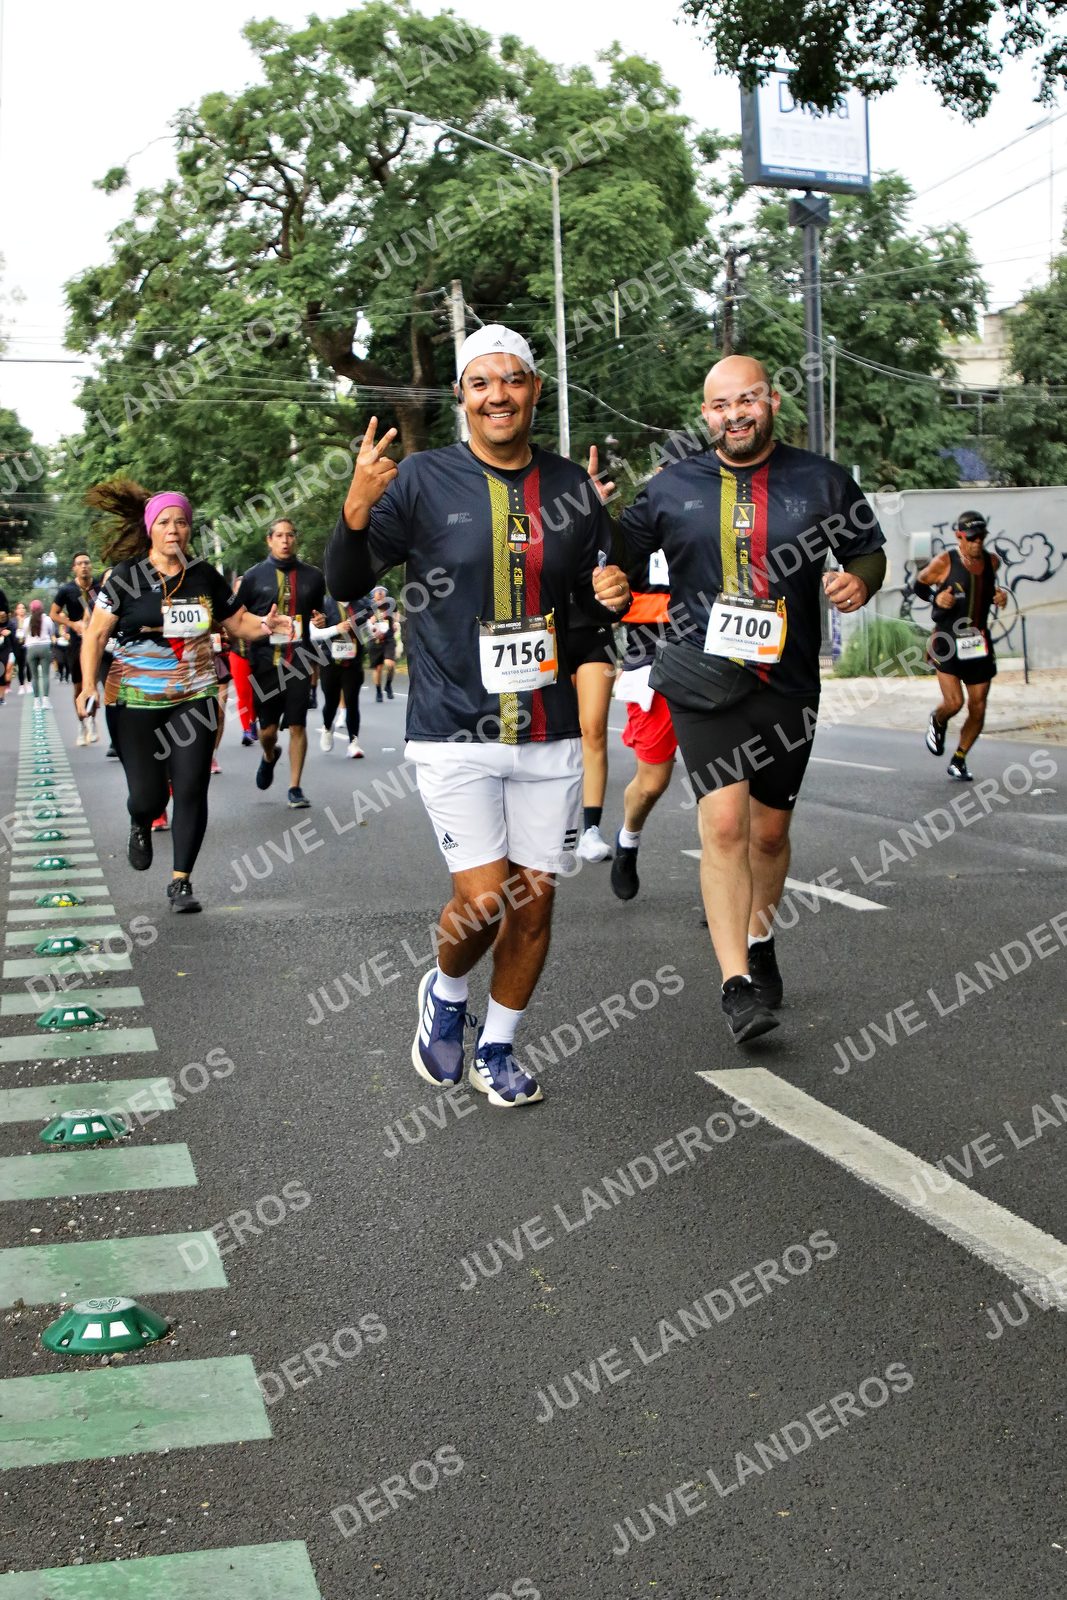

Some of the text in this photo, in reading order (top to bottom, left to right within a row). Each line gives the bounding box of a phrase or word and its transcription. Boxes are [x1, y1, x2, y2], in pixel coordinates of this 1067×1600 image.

[171, 610, 201, 624] 5001
[719, 612, 772, 640] 7100
[492, 639, 546, 668] 7156
